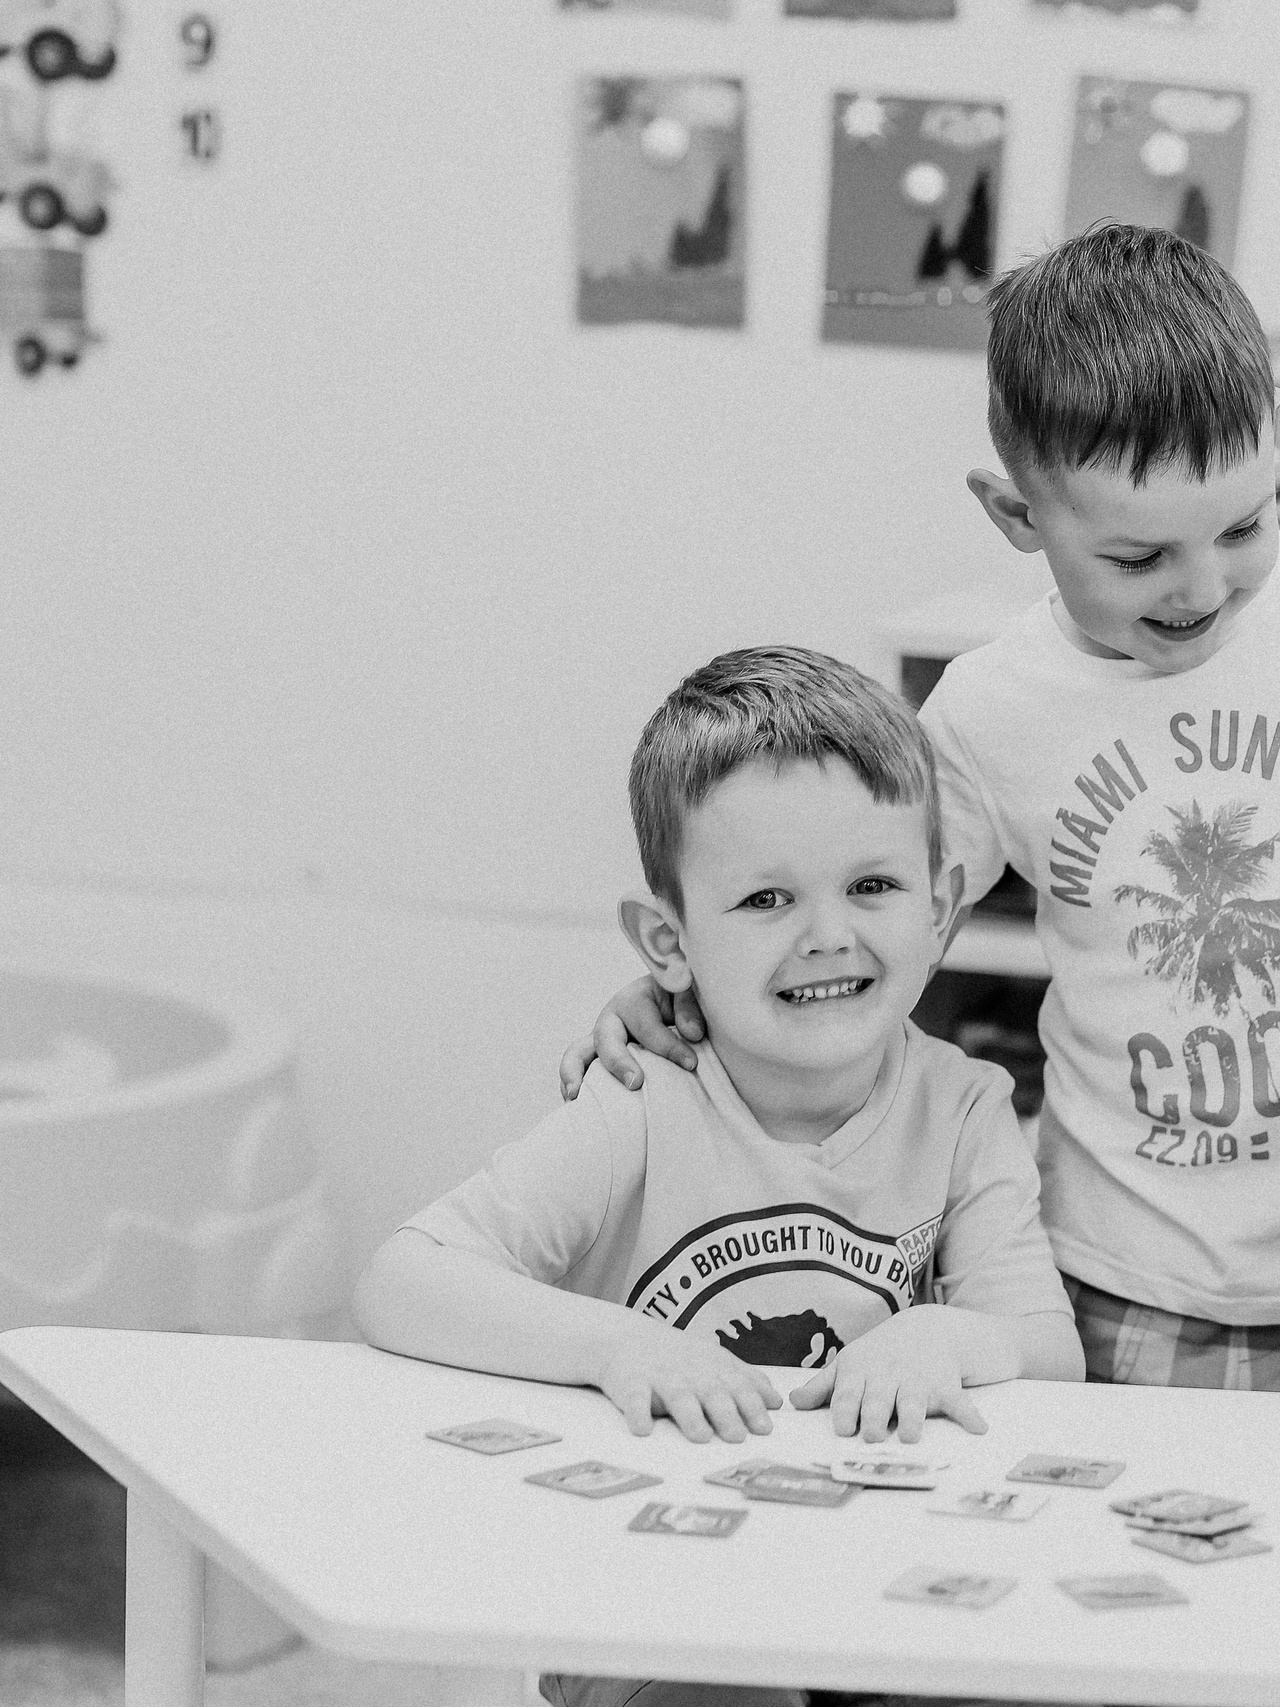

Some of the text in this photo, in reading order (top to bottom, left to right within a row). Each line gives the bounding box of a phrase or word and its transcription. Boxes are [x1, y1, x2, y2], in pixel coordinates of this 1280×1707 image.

[180, 12, 216, 72] 9
[1049, 738, 1148, 908] MIAMI
[691, 1225, 811, 1279] BROUGHT
[817, 1227, 835, 1256] TO
[839, 1237, 883, 1275] YOU
